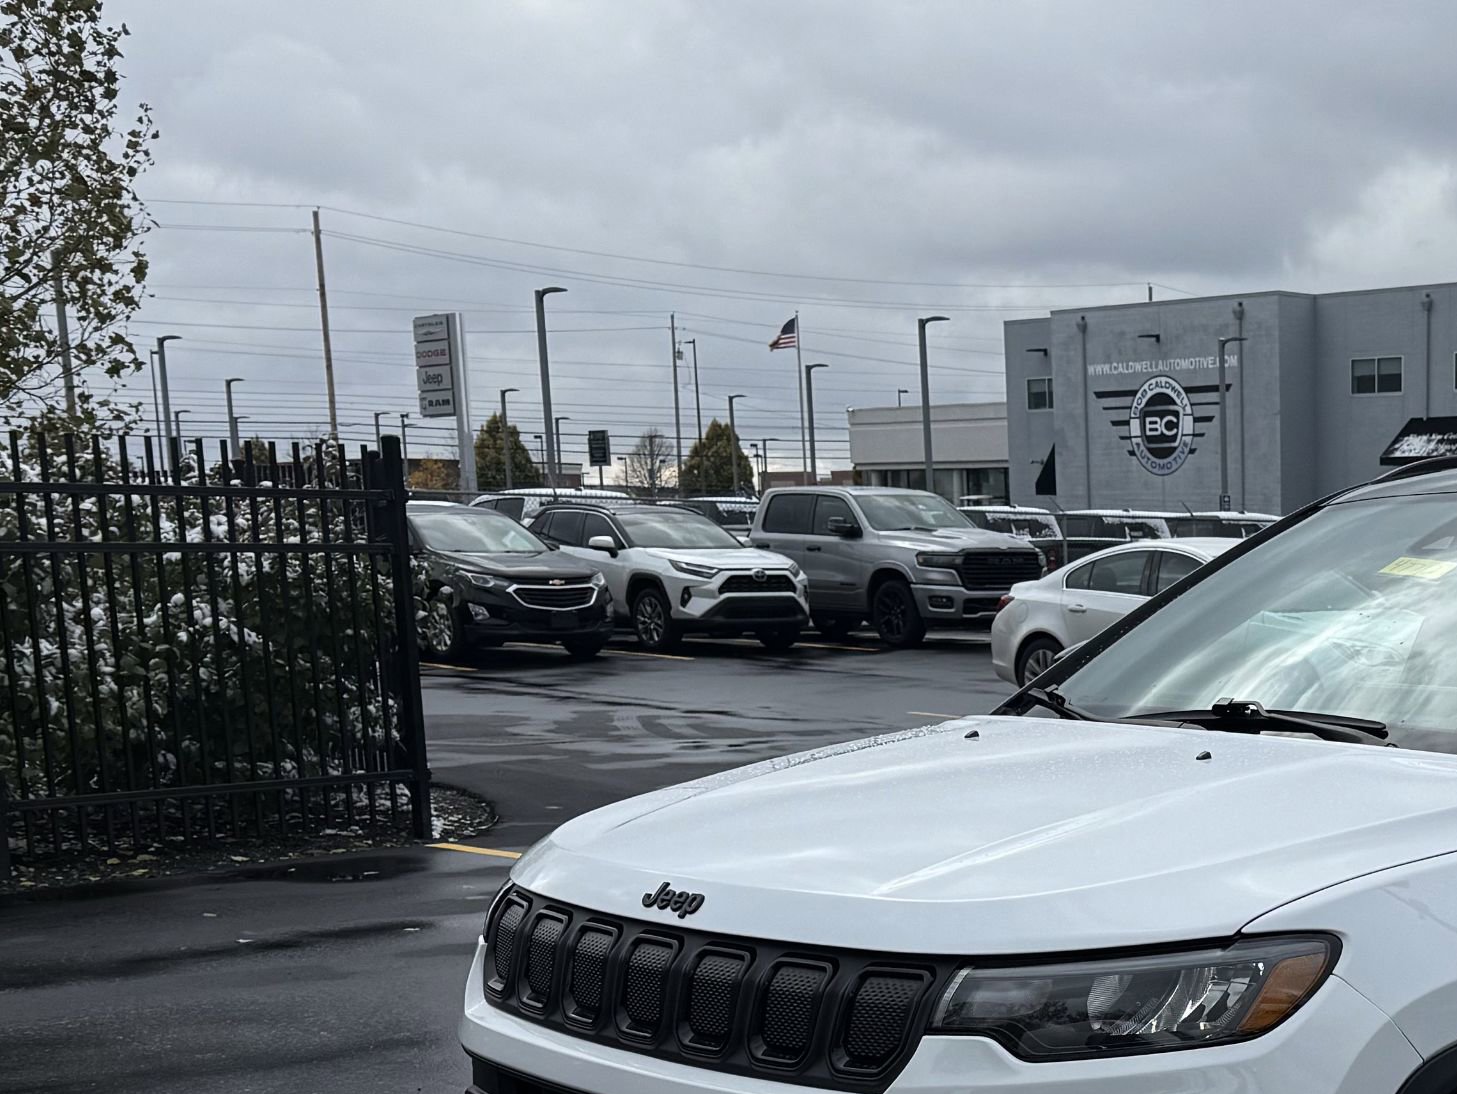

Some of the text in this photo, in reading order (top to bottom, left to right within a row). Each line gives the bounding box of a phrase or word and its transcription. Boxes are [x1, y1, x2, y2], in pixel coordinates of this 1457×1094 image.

[416, 349, 447, 359] DODGE
[422, 371, 443, 386] Jeep
[427, 399, 451, 408] RAM
[1132, 380, 1188, 416] BOB CALDWELL
[1146, 416, 1177, 435] BC
[1135, 442, 1189, 471] AUTOMOTIVE
[642, 881, 706, 920] Jeep
